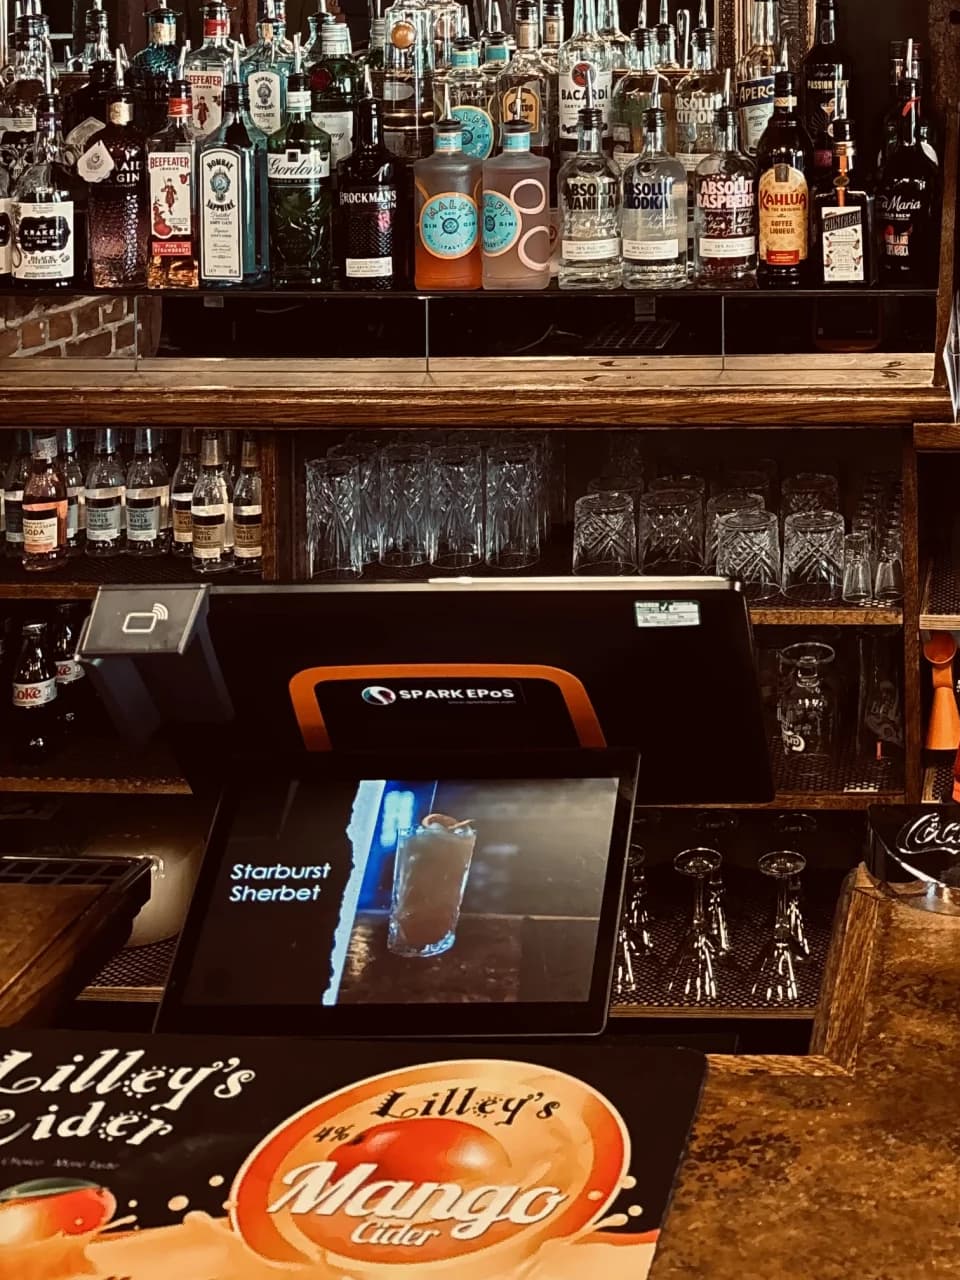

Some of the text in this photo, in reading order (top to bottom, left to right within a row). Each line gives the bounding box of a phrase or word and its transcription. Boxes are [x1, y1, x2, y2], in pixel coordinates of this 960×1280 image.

[739, 82, 775, 103] APERO
[675, 97, 722, 111] ABSOLU
[150, 156, 190, 169] BEEFEATER
[206, 158, 234, 172] BOMBAY
[116, 172, 140, 183] GIN
[701, 179, 754, 195] ABSOLUT
[339, 190, 397, 205] BROCKMANS
[697, 193, 755, 208] RASPBERR
[759, 189, 808, 211] KAHLÚA
[887, 195, 921, 211] Maria
[206, 199, 236, 212] SAPPHIRE
[769, 227, 796, 235] LIQUEUR
[771, 220, 793, 228] COFFEE
[14, 687, 41, 701] oke
[399, 688, 515, 699] SPARK EPoS
[230, 862, 332, 880] Starburst
[229, 884, 321, 902] Sherbet
[0, 1048, 256, 1111] Lilley's
[370, 1086, 561, 1126] Lilley's
[312, 1124, 354, 1143] 4%
[266, 1160, 570, 1241] Mango
[351, 1220, 441, 1248] Cider
